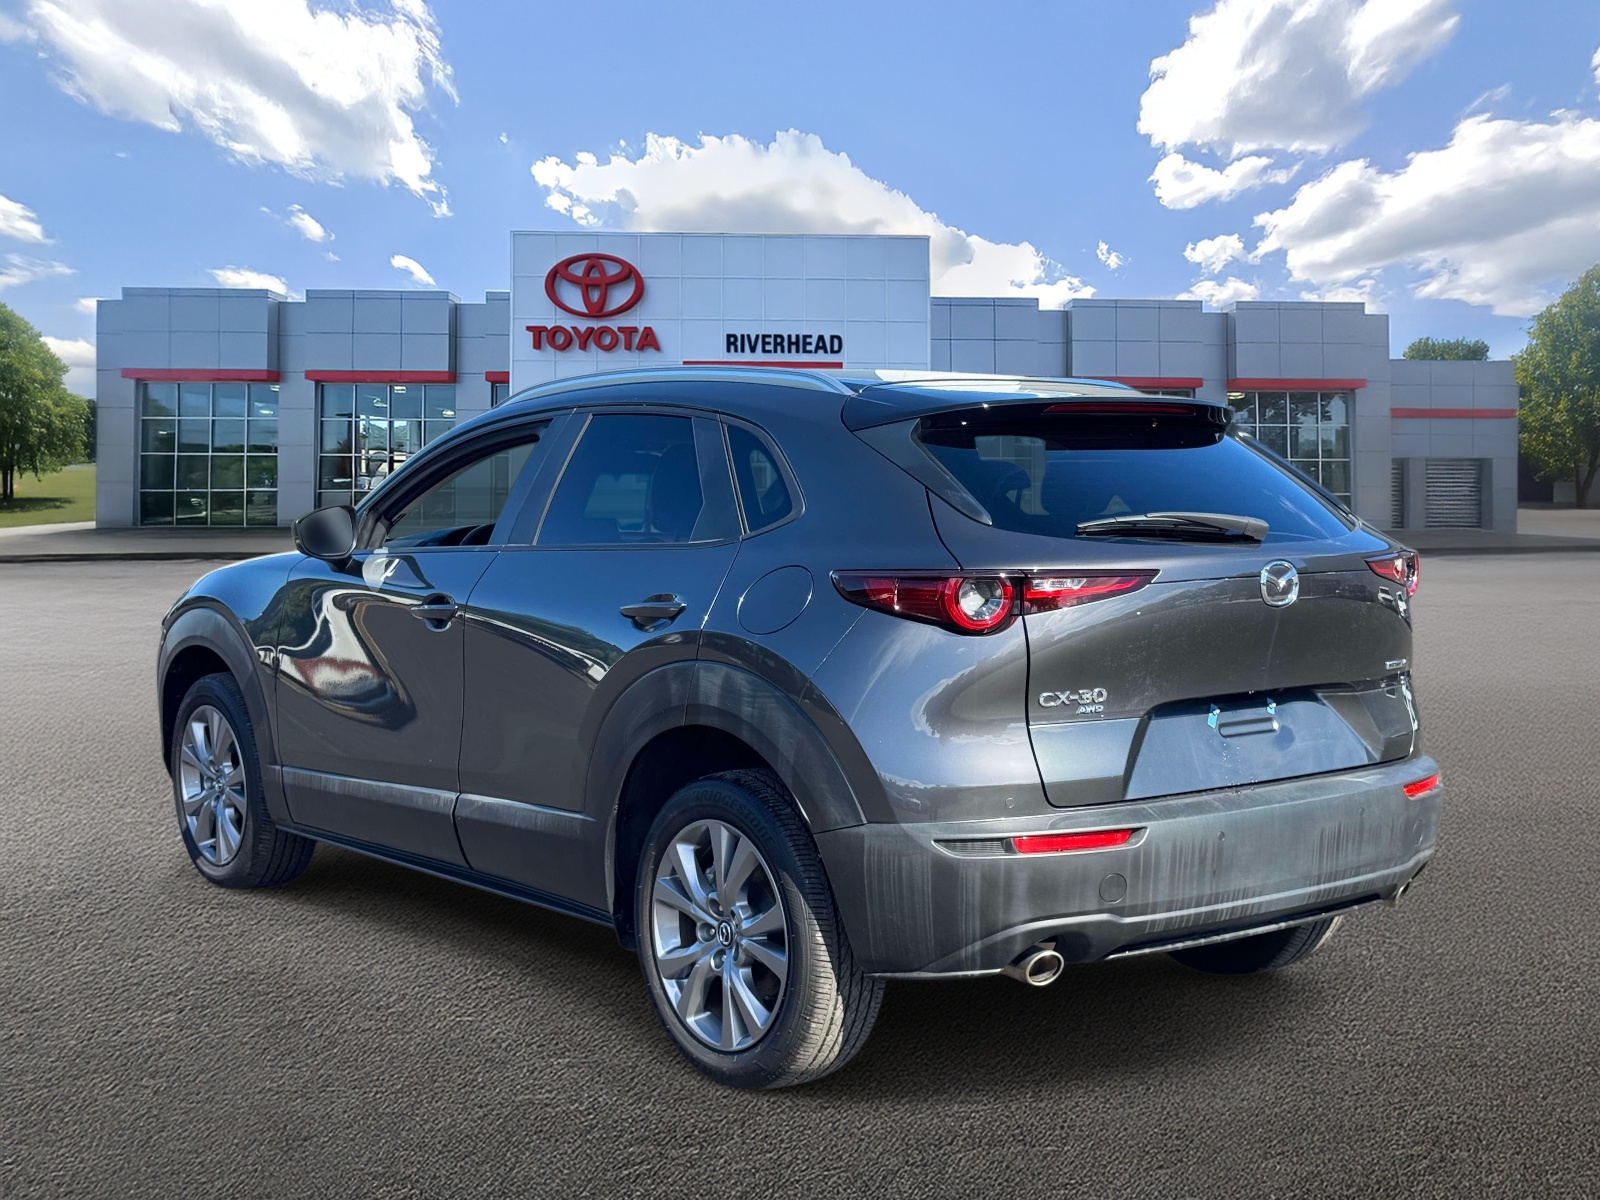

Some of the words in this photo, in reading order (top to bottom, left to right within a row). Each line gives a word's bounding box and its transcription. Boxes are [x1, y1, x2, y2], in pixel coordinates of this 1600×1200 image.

[525, 325, 661, 352] TOYOTA
[726, 333, 843, 354] RIVERHEAD
[1038, 687, 1108, 707] CX-30
[1076, 705, 1104, 715] AWD
